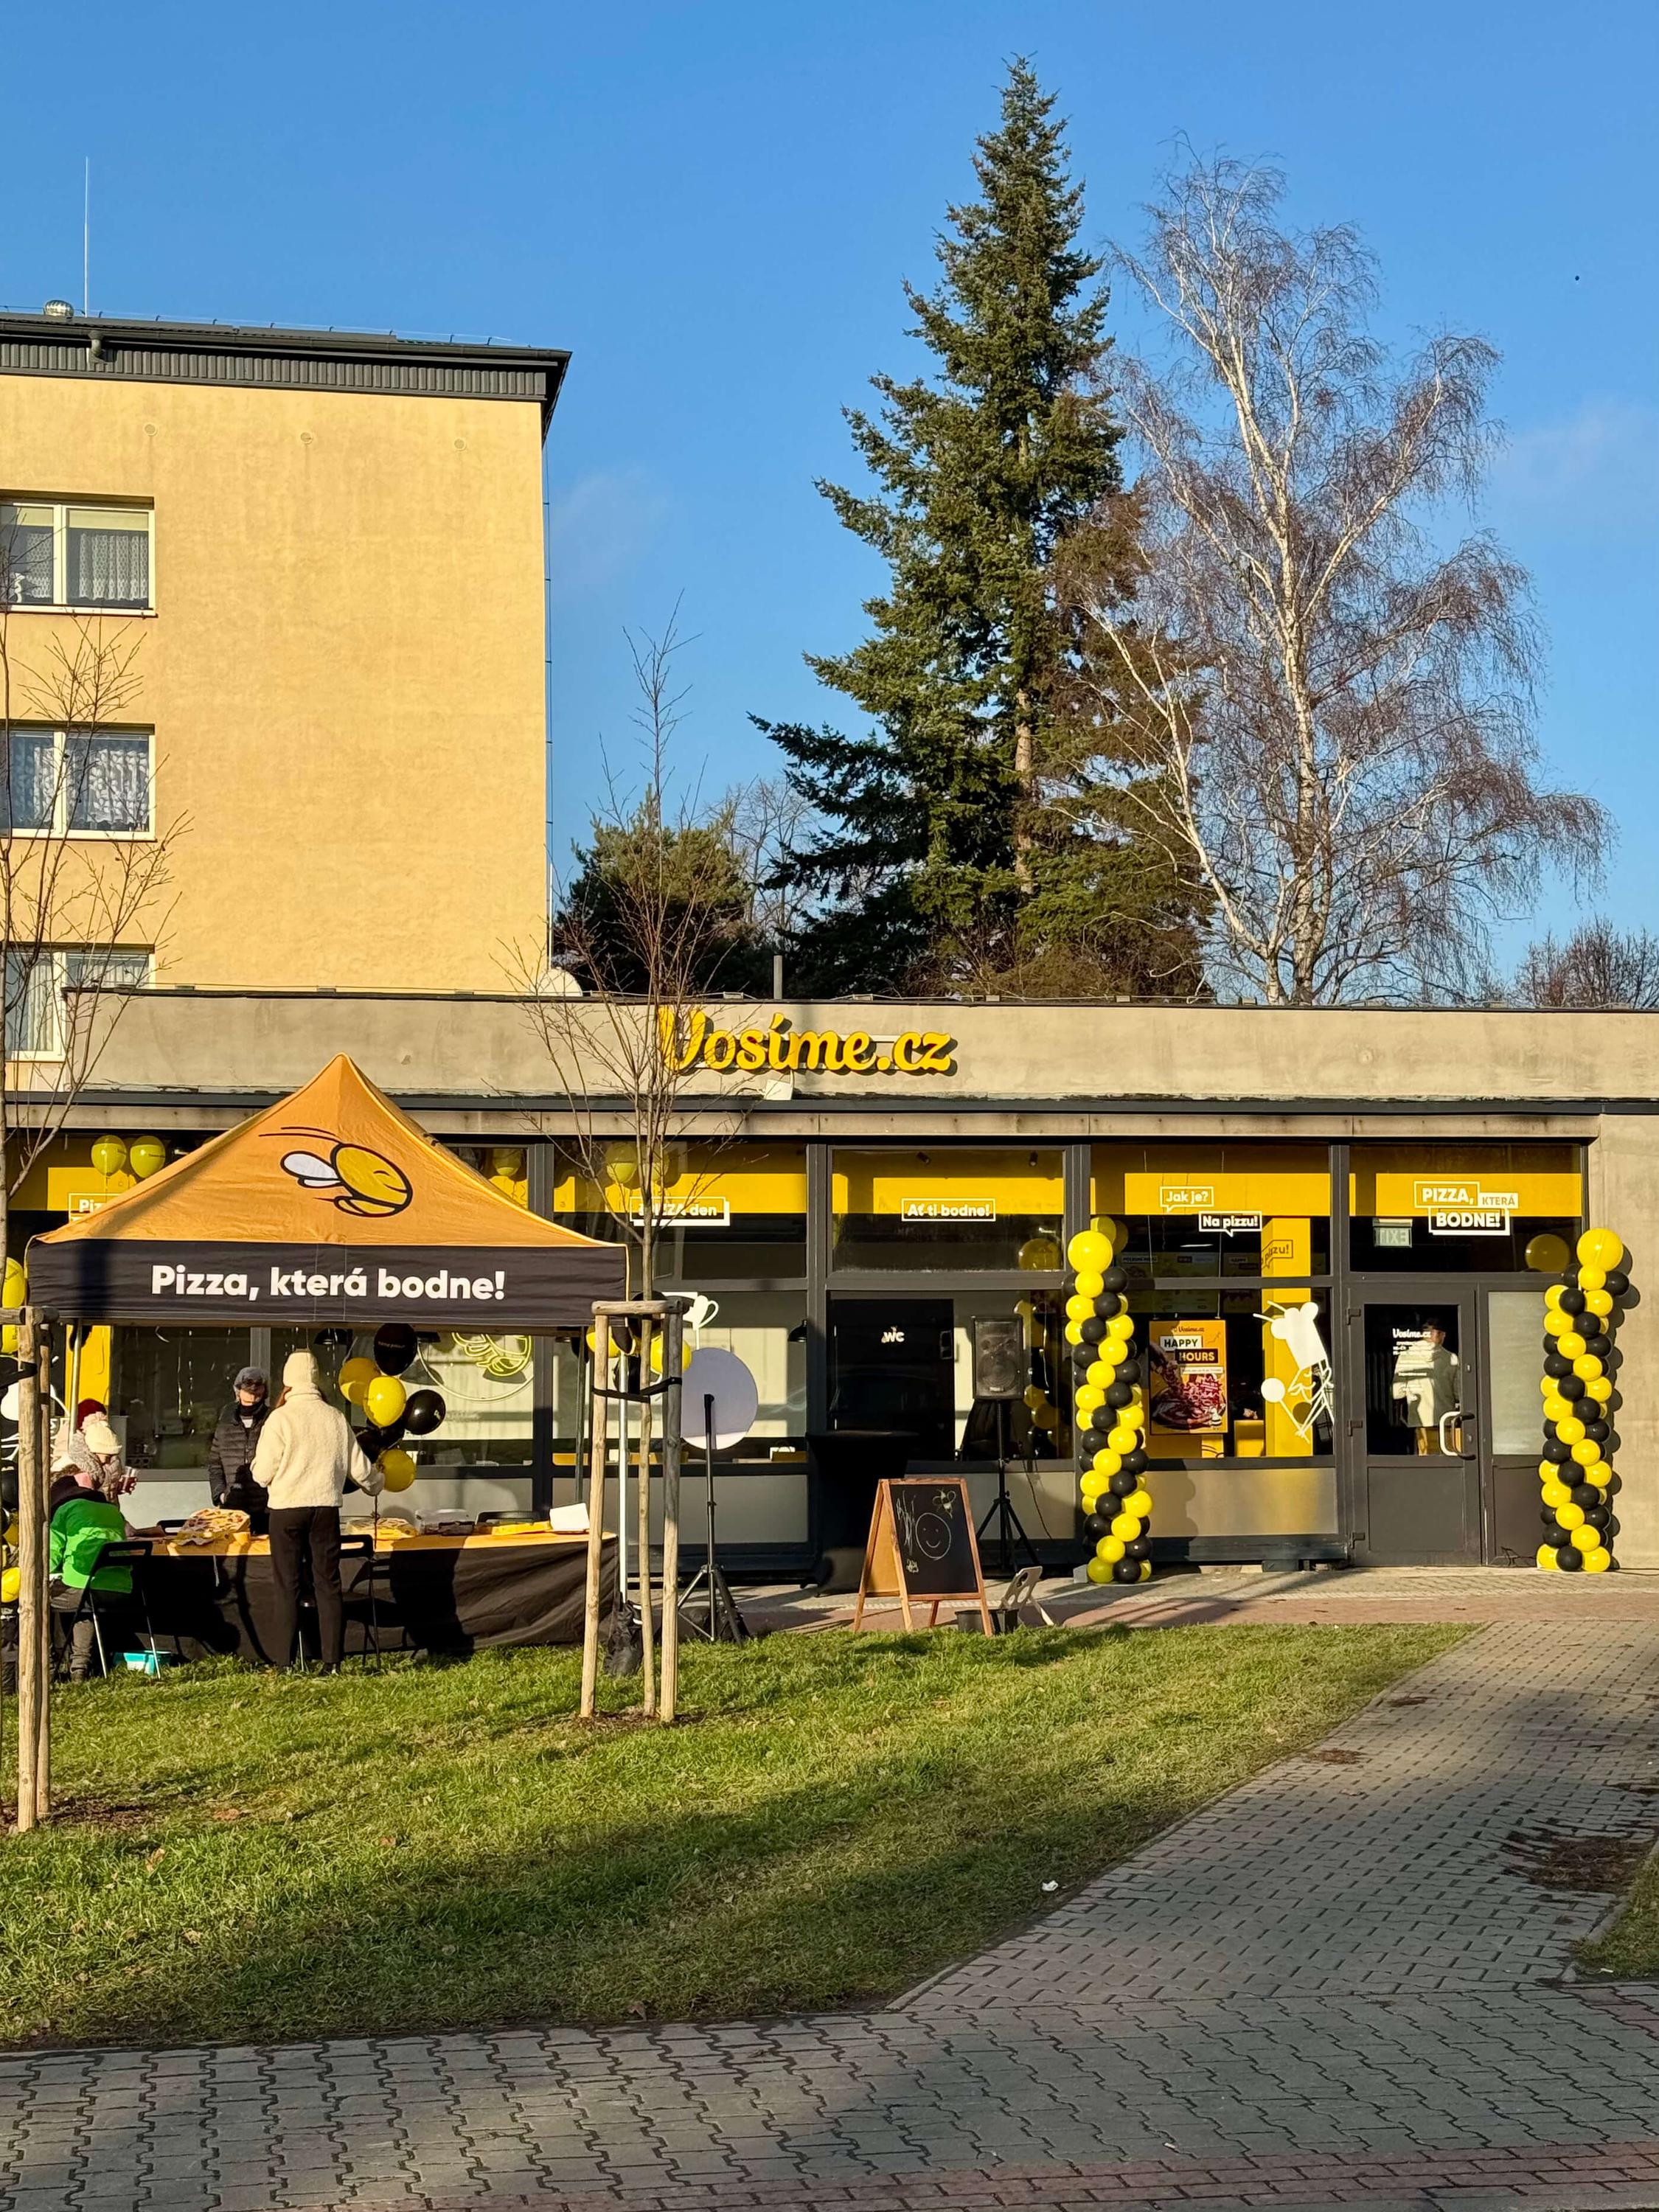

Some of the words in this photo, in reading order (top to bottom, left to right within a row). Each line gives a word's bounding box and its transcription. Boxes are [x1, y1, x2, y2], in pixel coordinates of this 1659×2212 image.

[658, 1006, 952, 1071] Vosíme.cz
[1166, 1191, 1188, 1203] Jak
[1190, 1191, 1208, 1205] je?
[1422, 1188, 1474, 1205] PIZZA,
[1482, 1194, 1515, 1206] KTERÁ
[689, 1203, 717, 1216] den
[941, 1203, 990, 1217] bodne!
[1203, 1216, 1220, 1227] Na
[1222, 1215, 1259, 1229] pizzu!
[1436, 1212, 1500, 1228] BODNE!
[152, 1264, 259, 1301] Pizza,
[270, 1267, 367, 1297] která
[378, 1268, 505, 1300] bodne!
[883, 1332, 905, 1342] WC
[1164, 1338, 1198, 1348] HAPPY
[1178, 1352, 1215, 1362] HOURS
